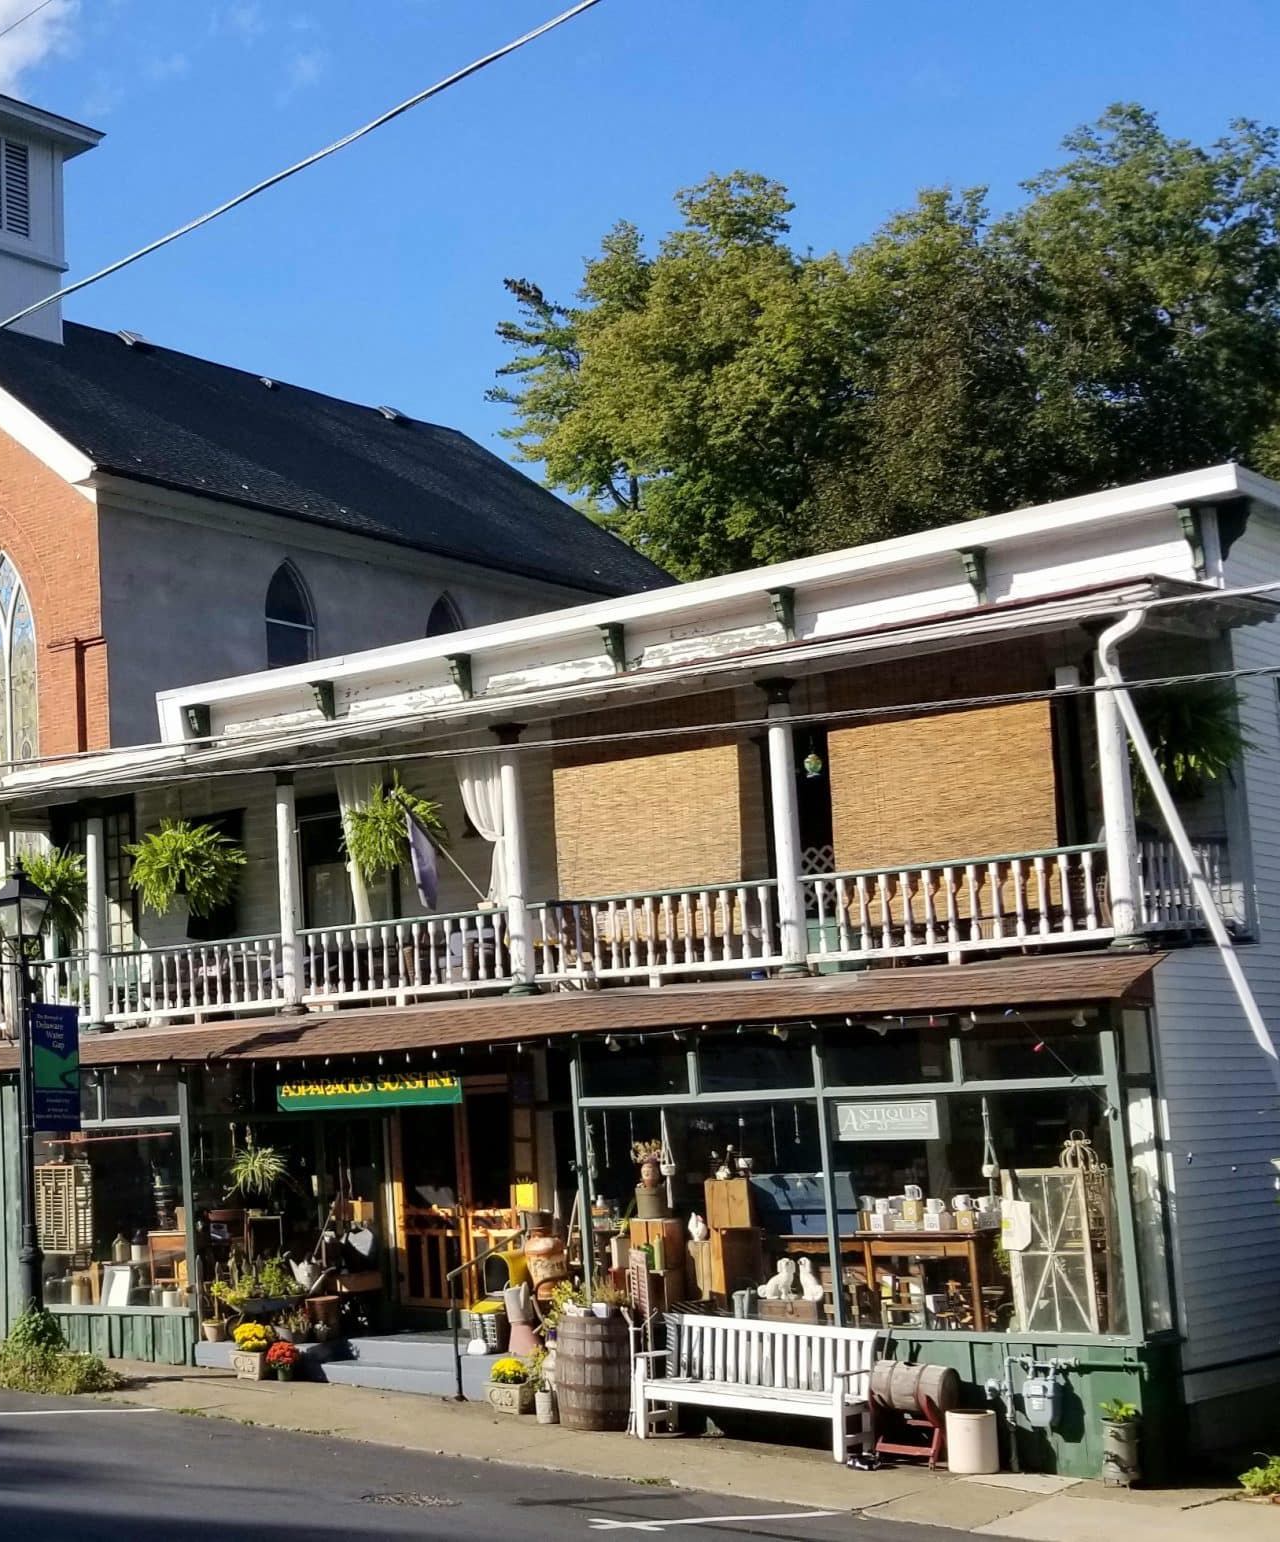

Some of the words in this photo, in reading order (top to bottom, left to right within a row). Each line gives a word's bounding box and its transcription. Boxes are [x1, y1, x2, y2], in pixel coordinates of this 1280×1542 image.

[35, 1020, 64, 1030] Delaware
[46, 1031, 64, 1039] Water
[52, 1040, 65, 1051] Gap
[281, 1075, 374, 1097] ASPARAGUS
[840, 1106, 928, 1131] ANTIQUES
